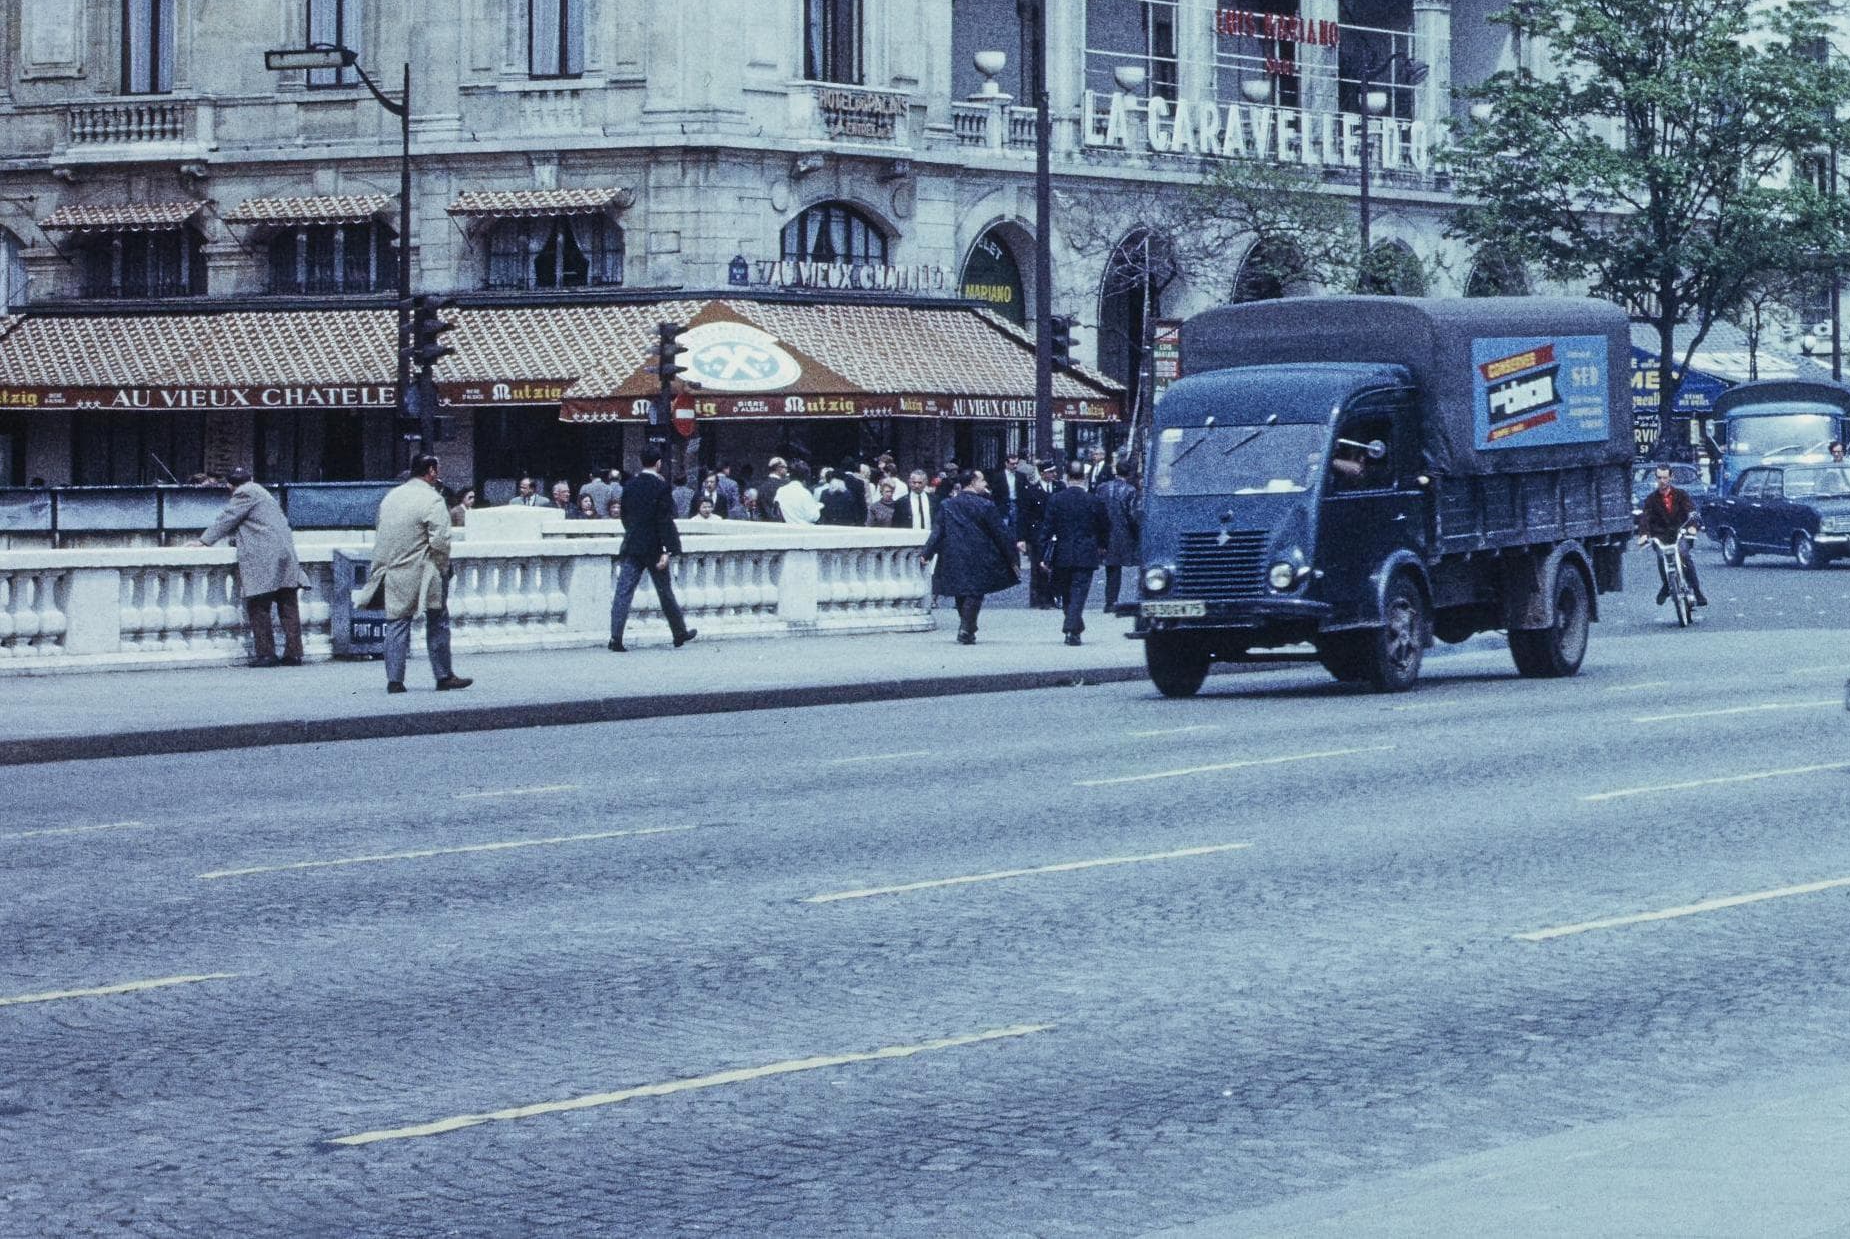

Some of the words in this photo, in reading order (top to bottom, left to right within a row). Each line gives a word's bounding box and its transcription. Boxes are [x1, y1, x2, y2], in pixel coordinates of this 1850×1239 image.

[1085, 89, 1130, 147] LA
[1148, 96, 1361, 167] CARAVELLE
[800, 262, 852, 289] VIEUX
[965, 284, 1012, 303] MARIANO
[111, 389, 150, 408] AU
[160, 389, 250, 408] VIEUX
[261, 387, 396, 406] CHATELE
[492, 384, 563, 402] Mutzig
[784, 396, 856, 414] Mutzig
[953, 399, 967, 416] AU
[969, 399, 1000, 416] VIEUX
[1002, 400, 1036, 417] CHATE
